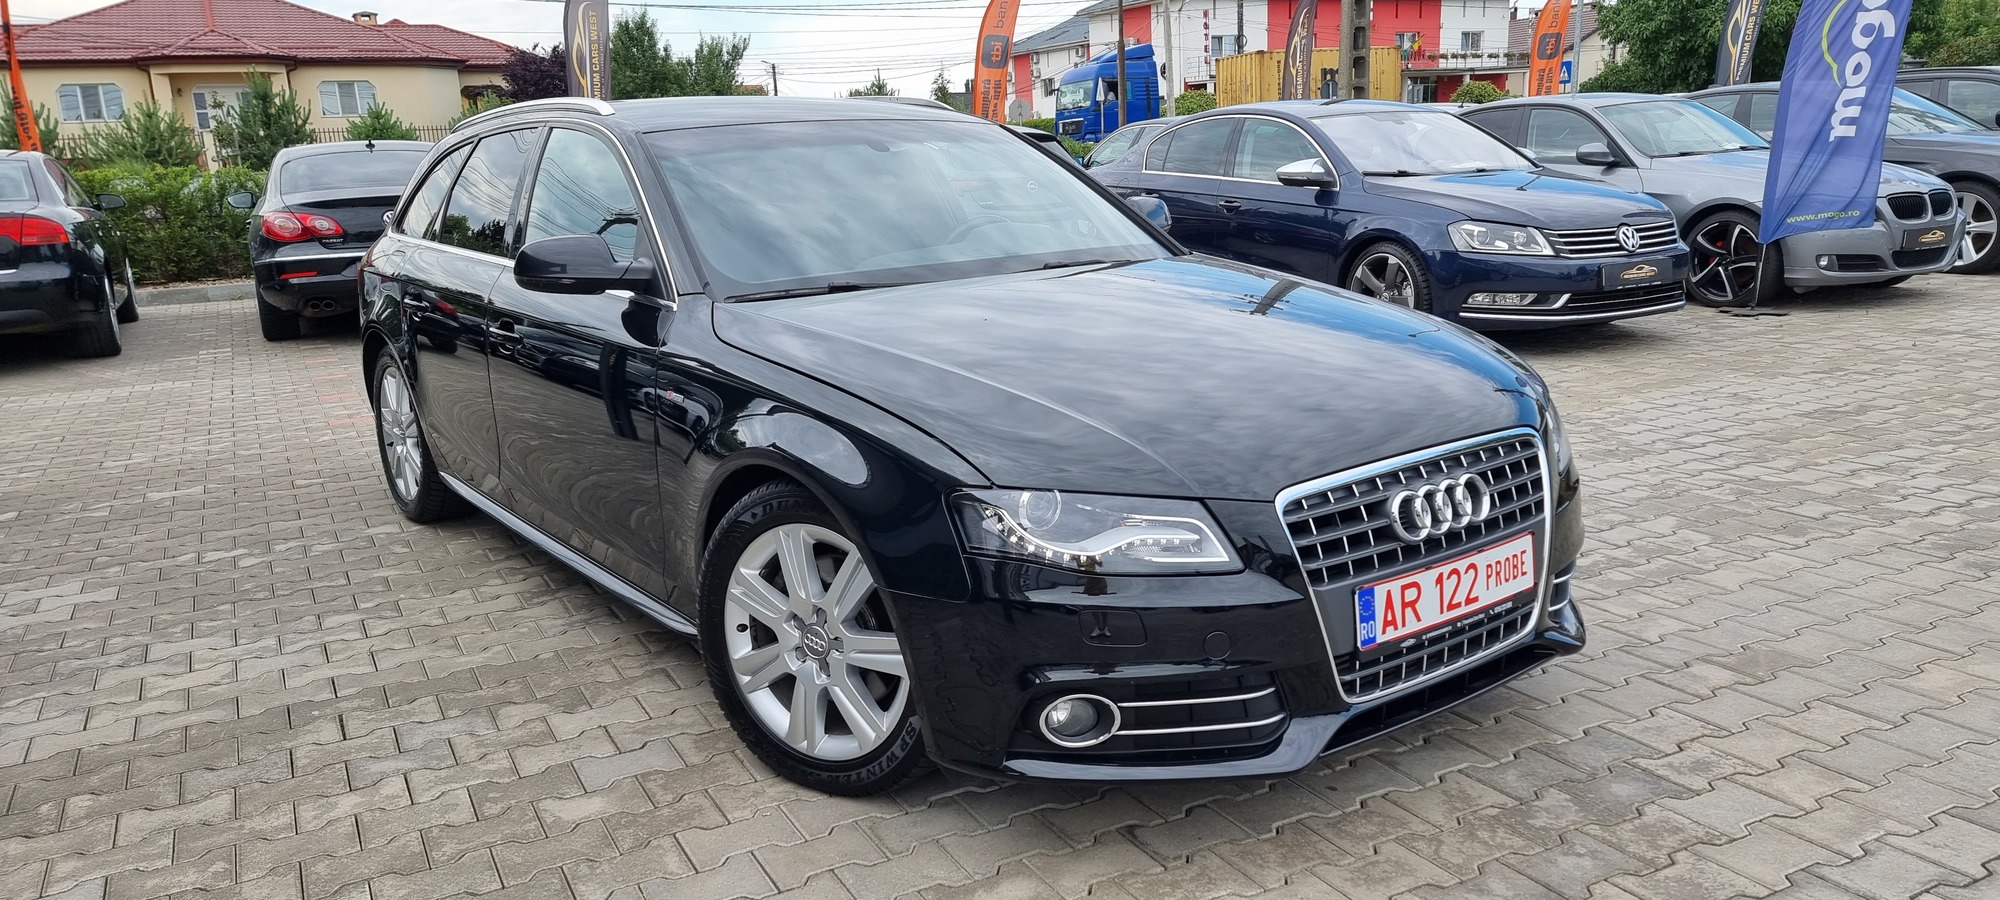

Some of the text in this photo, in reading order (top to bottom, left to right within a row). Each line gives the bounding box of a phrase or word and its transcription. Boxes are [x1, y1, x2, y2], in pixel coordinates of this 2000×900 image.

[589, 10, 598, 41] WEST
[1745, 16, 1756, 41] CARS
[591, 43, 600, 71] CARS
[991, 41, 1003, 62] tbi
[1546, 38, 1556, 55] tbi
[1829, 0, 1895, 142] mog
[1786, 210, 1860, 224] www.mogo.ro
[1381, 550, 1528, 636] AR 122 PROBE
[1361, 620, 1376, 641] RO
[899, 720, 918, 752] SP
